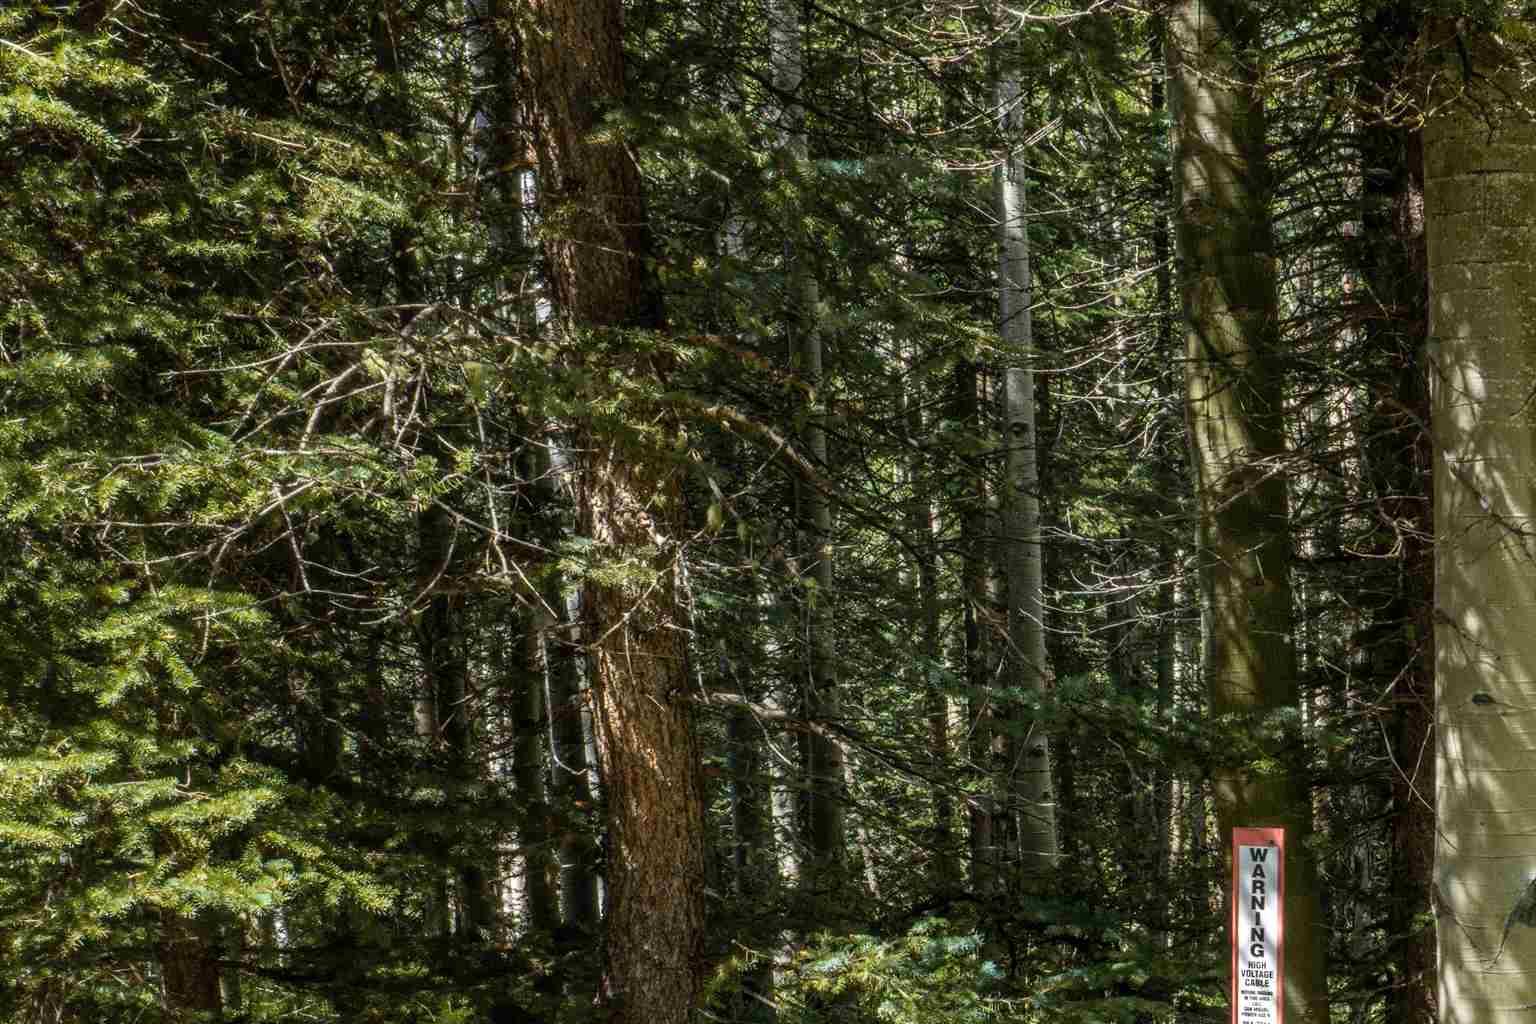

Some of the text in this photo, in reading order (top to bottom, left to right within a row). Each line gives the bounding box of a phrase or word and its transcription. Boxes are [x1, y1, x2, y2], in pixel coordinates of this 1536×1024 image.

[1250, 847, 1268, 958] WARNING
[1248, 961, 1267, 969] HIGH
[1241, 970, 1273, 979] VOLTAGE
[1245, 979, 1270, 987] CABLE
